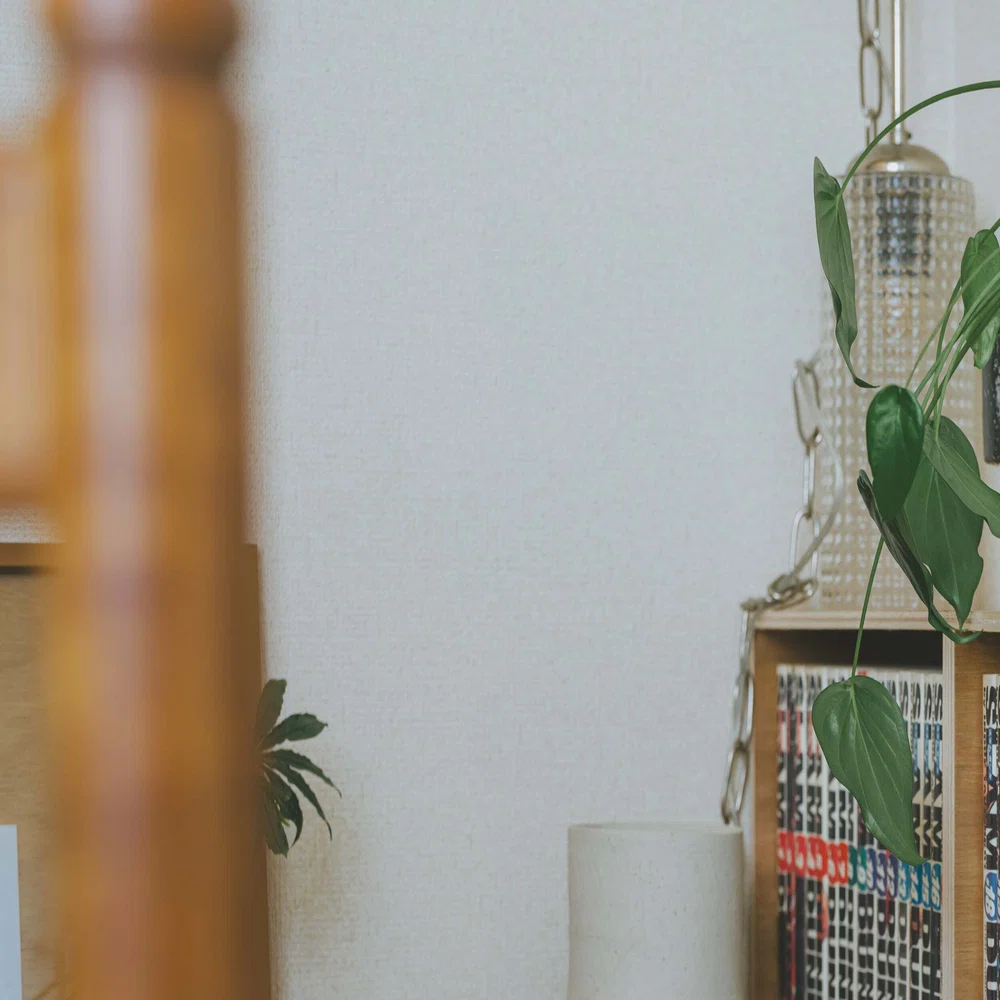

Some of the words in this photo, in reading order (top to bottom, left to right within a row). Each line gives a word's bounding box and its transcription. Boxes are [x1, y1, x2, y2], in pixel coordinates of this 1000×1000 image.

[923, 683, 932, 860] SLAM
[934, 684, 943, 861] SLAM
[986, 685, 997, 870] SLAM
